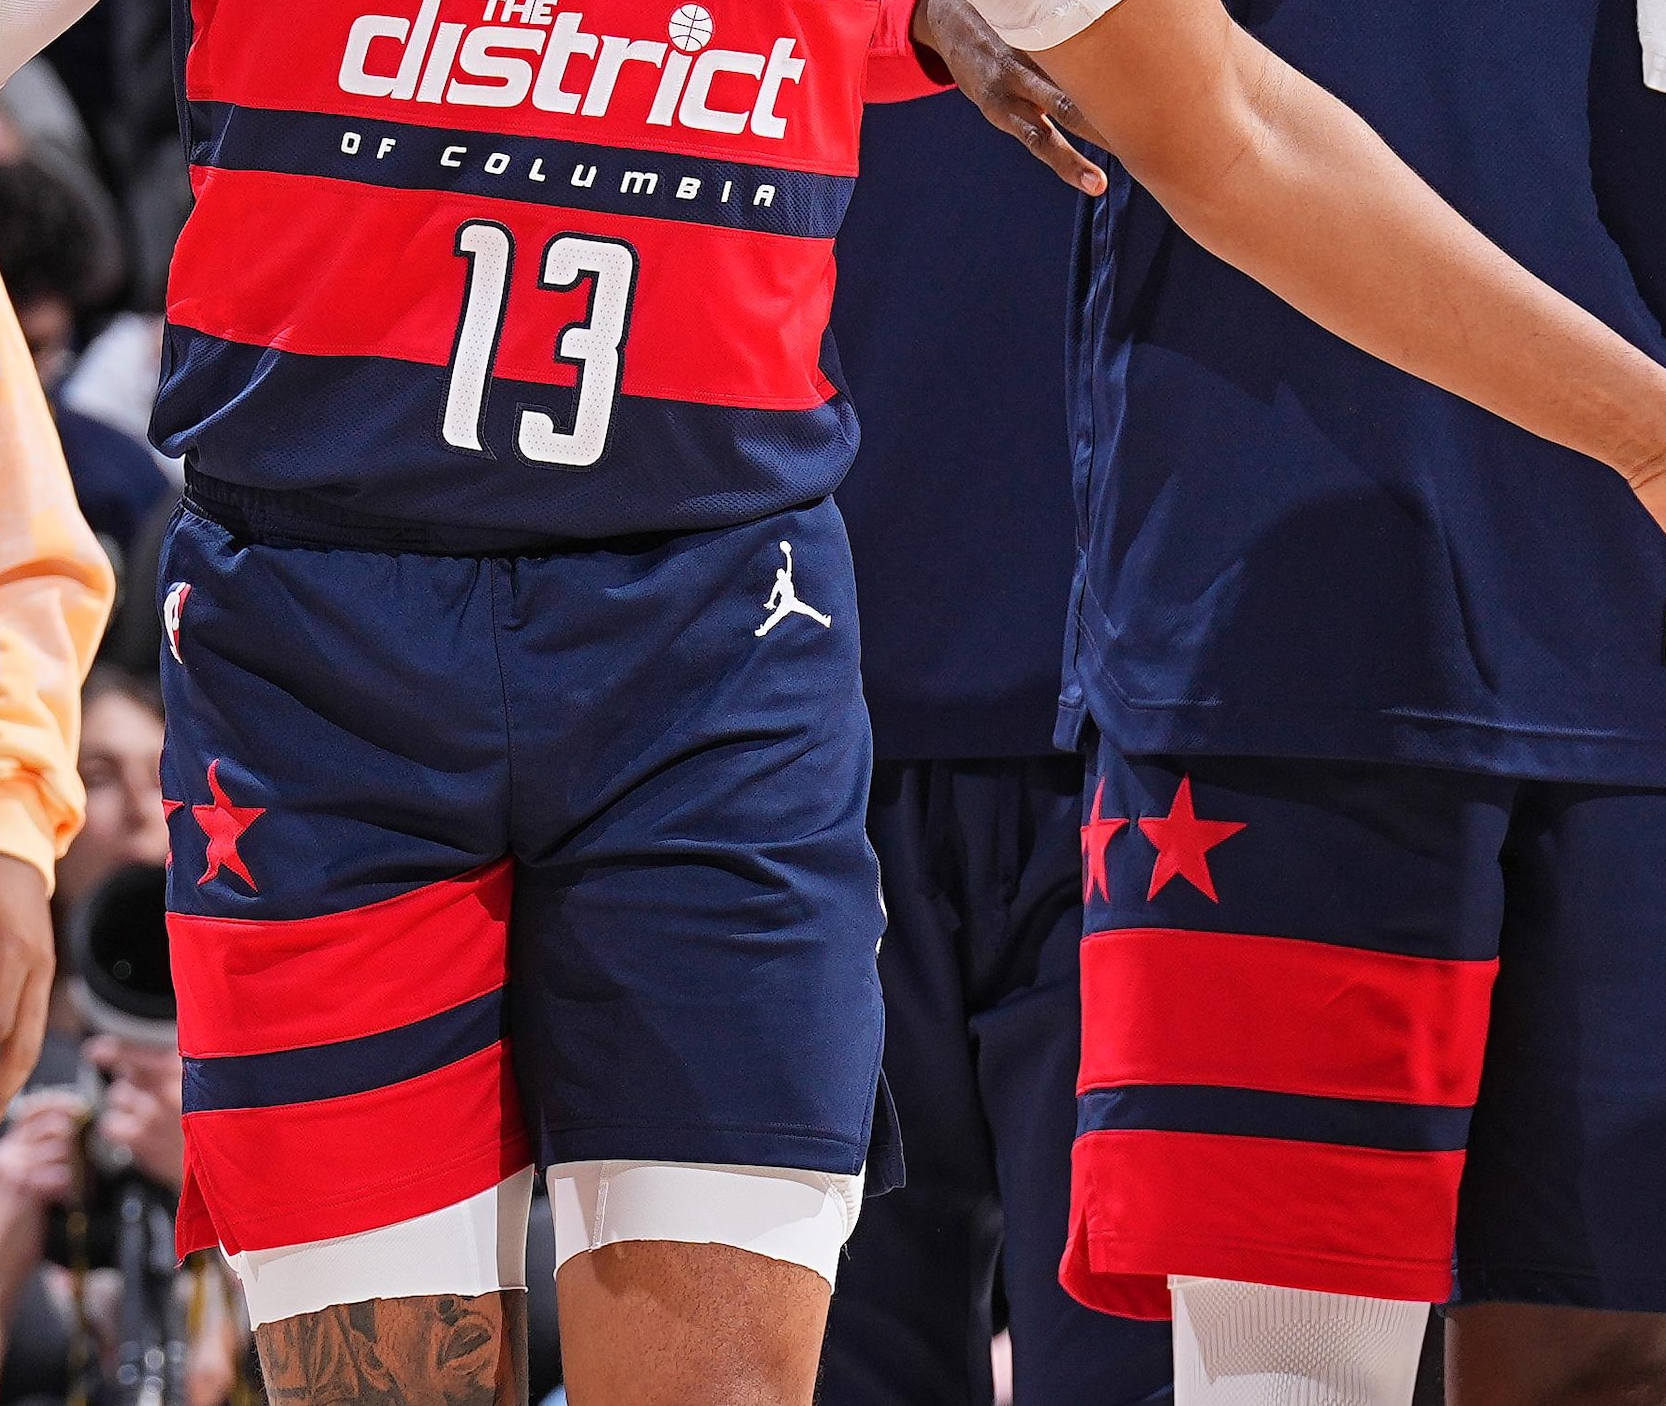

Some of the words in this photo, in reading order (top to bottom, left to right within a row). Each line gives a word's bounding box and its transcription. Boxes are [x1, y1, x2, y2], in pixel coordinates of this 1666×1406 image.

[340, 130, 398, 160] OF
[439, 144, 777, 209] COLUMBIA
[439, 221, 635, 469] 13
